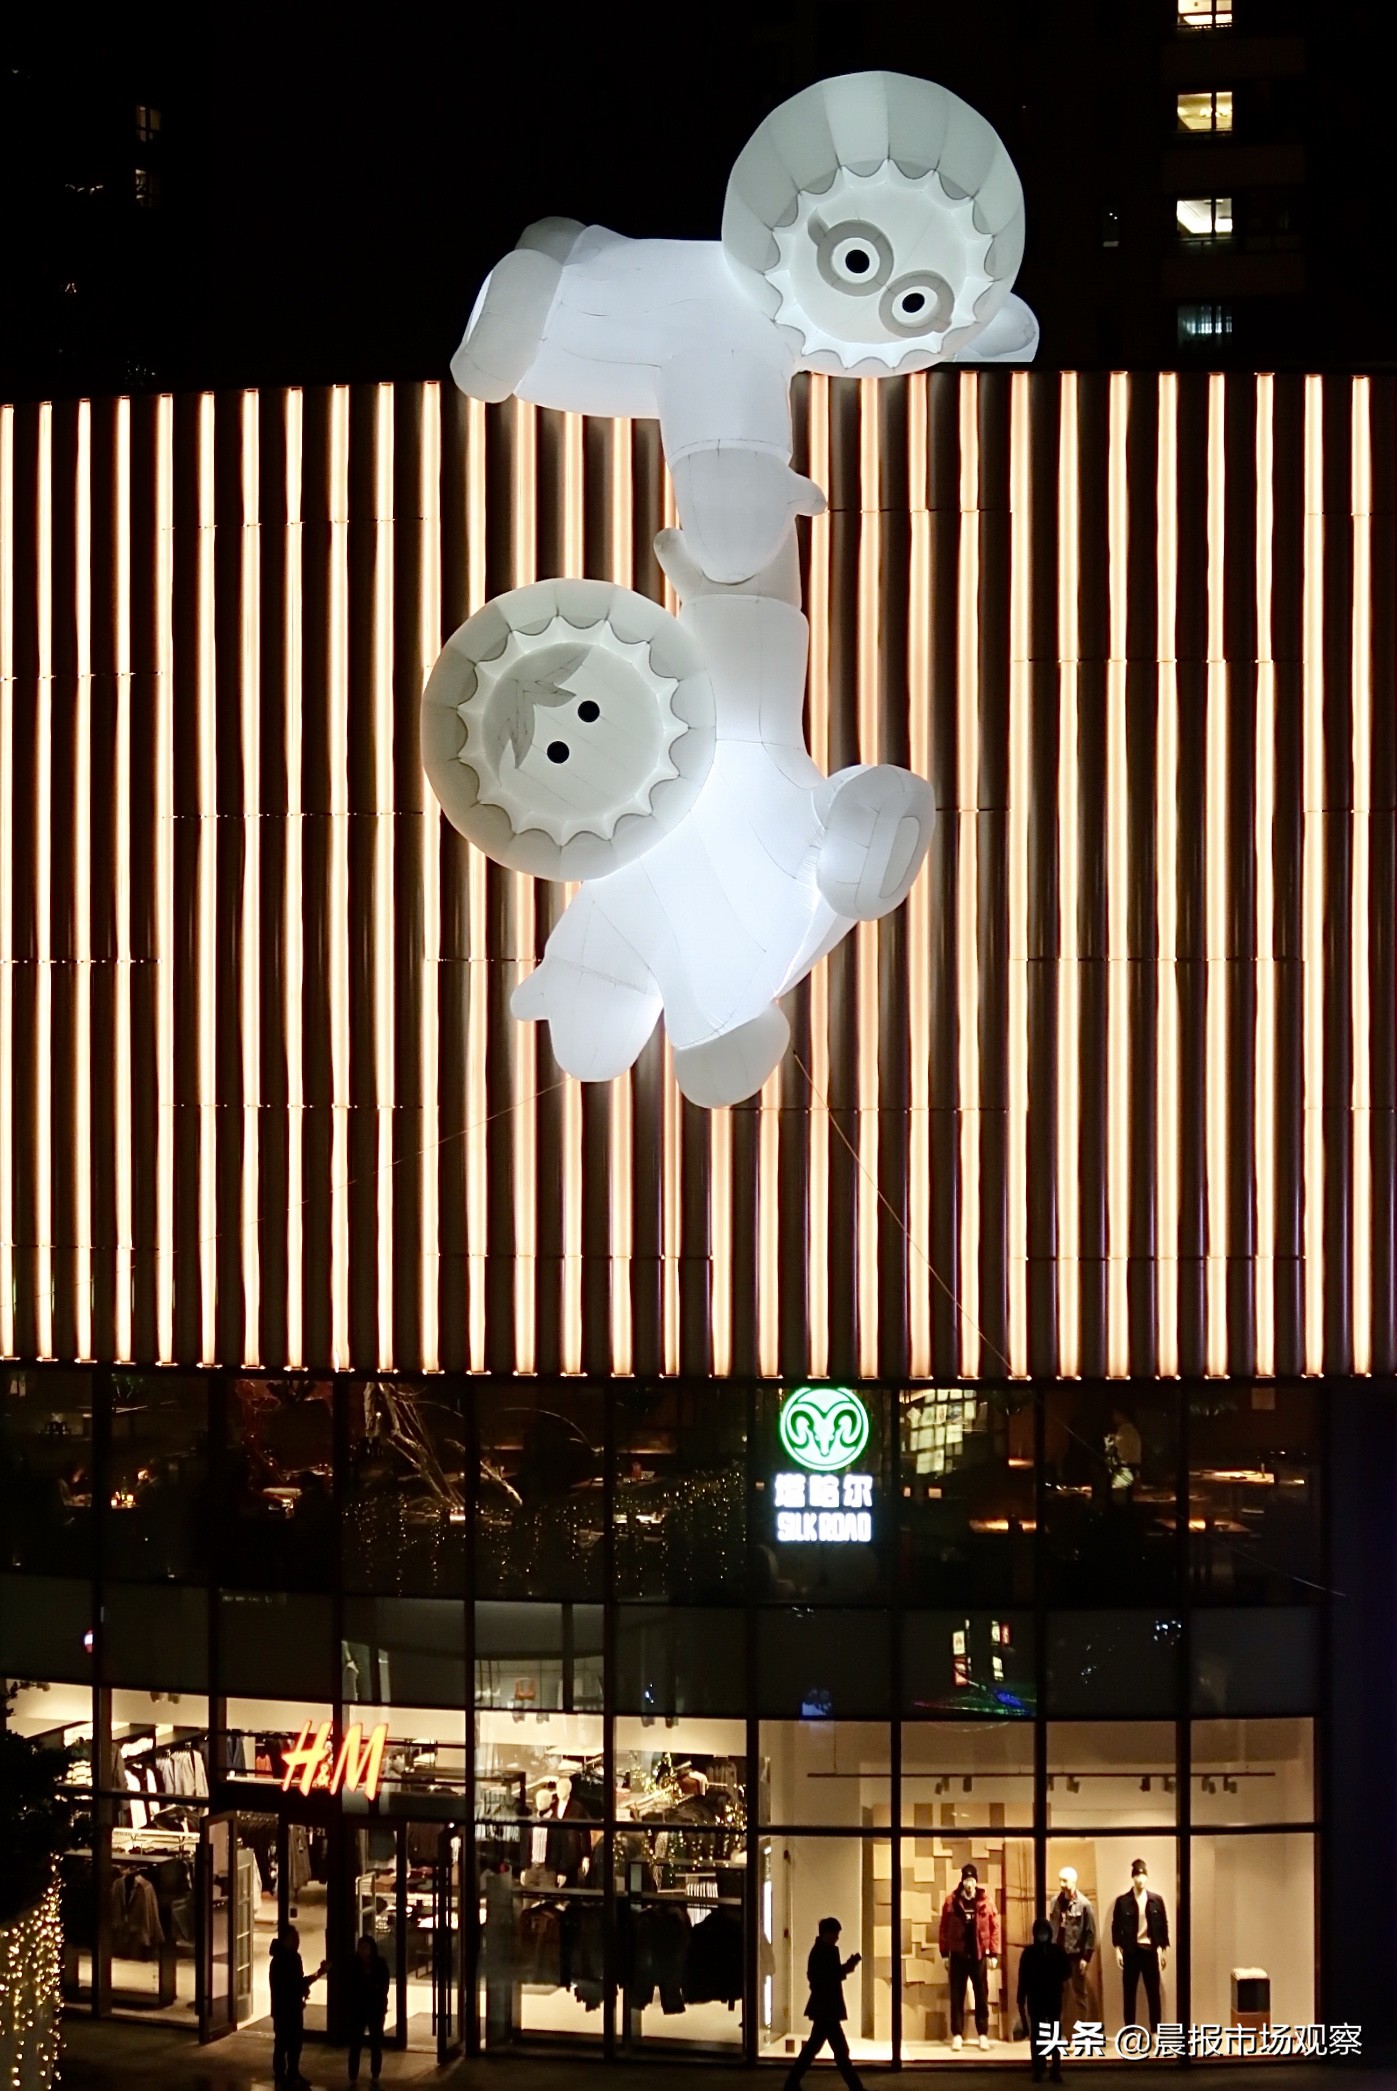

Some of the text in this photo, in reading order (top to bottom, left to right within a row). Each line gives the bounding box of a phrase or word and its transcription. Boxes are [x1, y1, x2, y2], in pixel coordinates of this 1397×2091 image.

[777, 1512, 871, 1542] SILK ROAD
[281, 1720, 388, 1801] H&M
